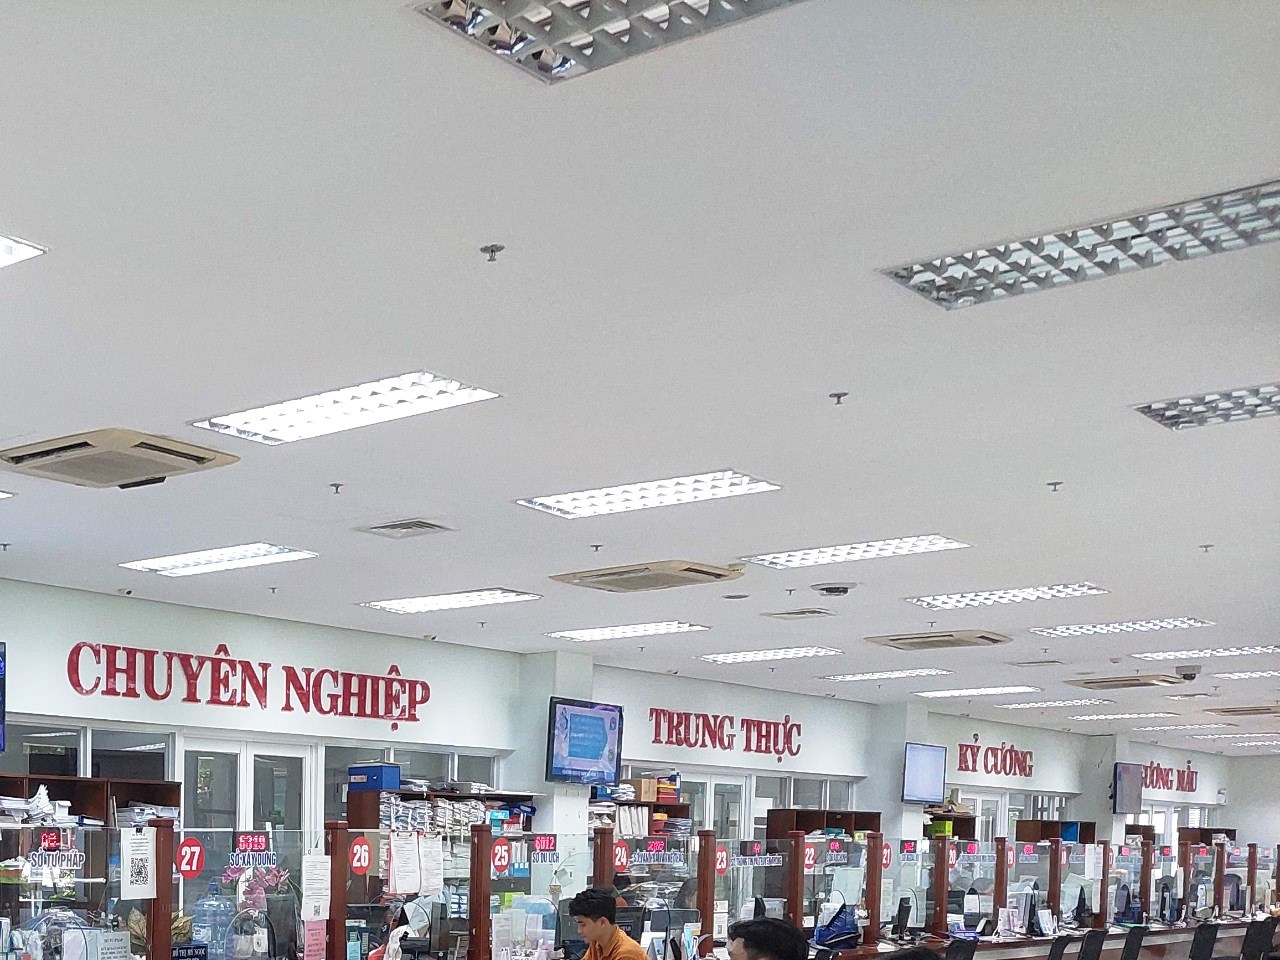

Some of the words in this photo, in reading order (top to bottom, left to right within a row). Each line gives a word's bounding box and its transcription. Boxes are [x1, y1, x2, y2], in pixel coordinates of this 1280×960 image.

[67, 642, 270, 709] CHUYÊN
[281, 664, 430, 732] NGHIỆP
[649, 708, 736, 751] TRUNG
[740, 714, 801, 763] THỰC
[957, 733, 981, 773] KỶ
[983, 742, 1034, 777] CƯƠNG
[31, 848, 44, 867] SỞ
[47, 852, 59, 867] TƯ
[61, 851, 85, 868] PHÁP
[181, 846, 200, 871] 27
[231, 848, 240, 866] SỞ
[242, 850, 256, 866] XÂY
[352, 845, 369, 868] 26
[494, 843, 508, 866] 25
[533, 850, 540, 863] SỞ
[541, 852, 548, 863] DU
[615, 846, 627, 866] 24
[716, 851, 727, 869] 23
[805, 847, 814, 864] 22
[883, 848, 890, 864] 21
